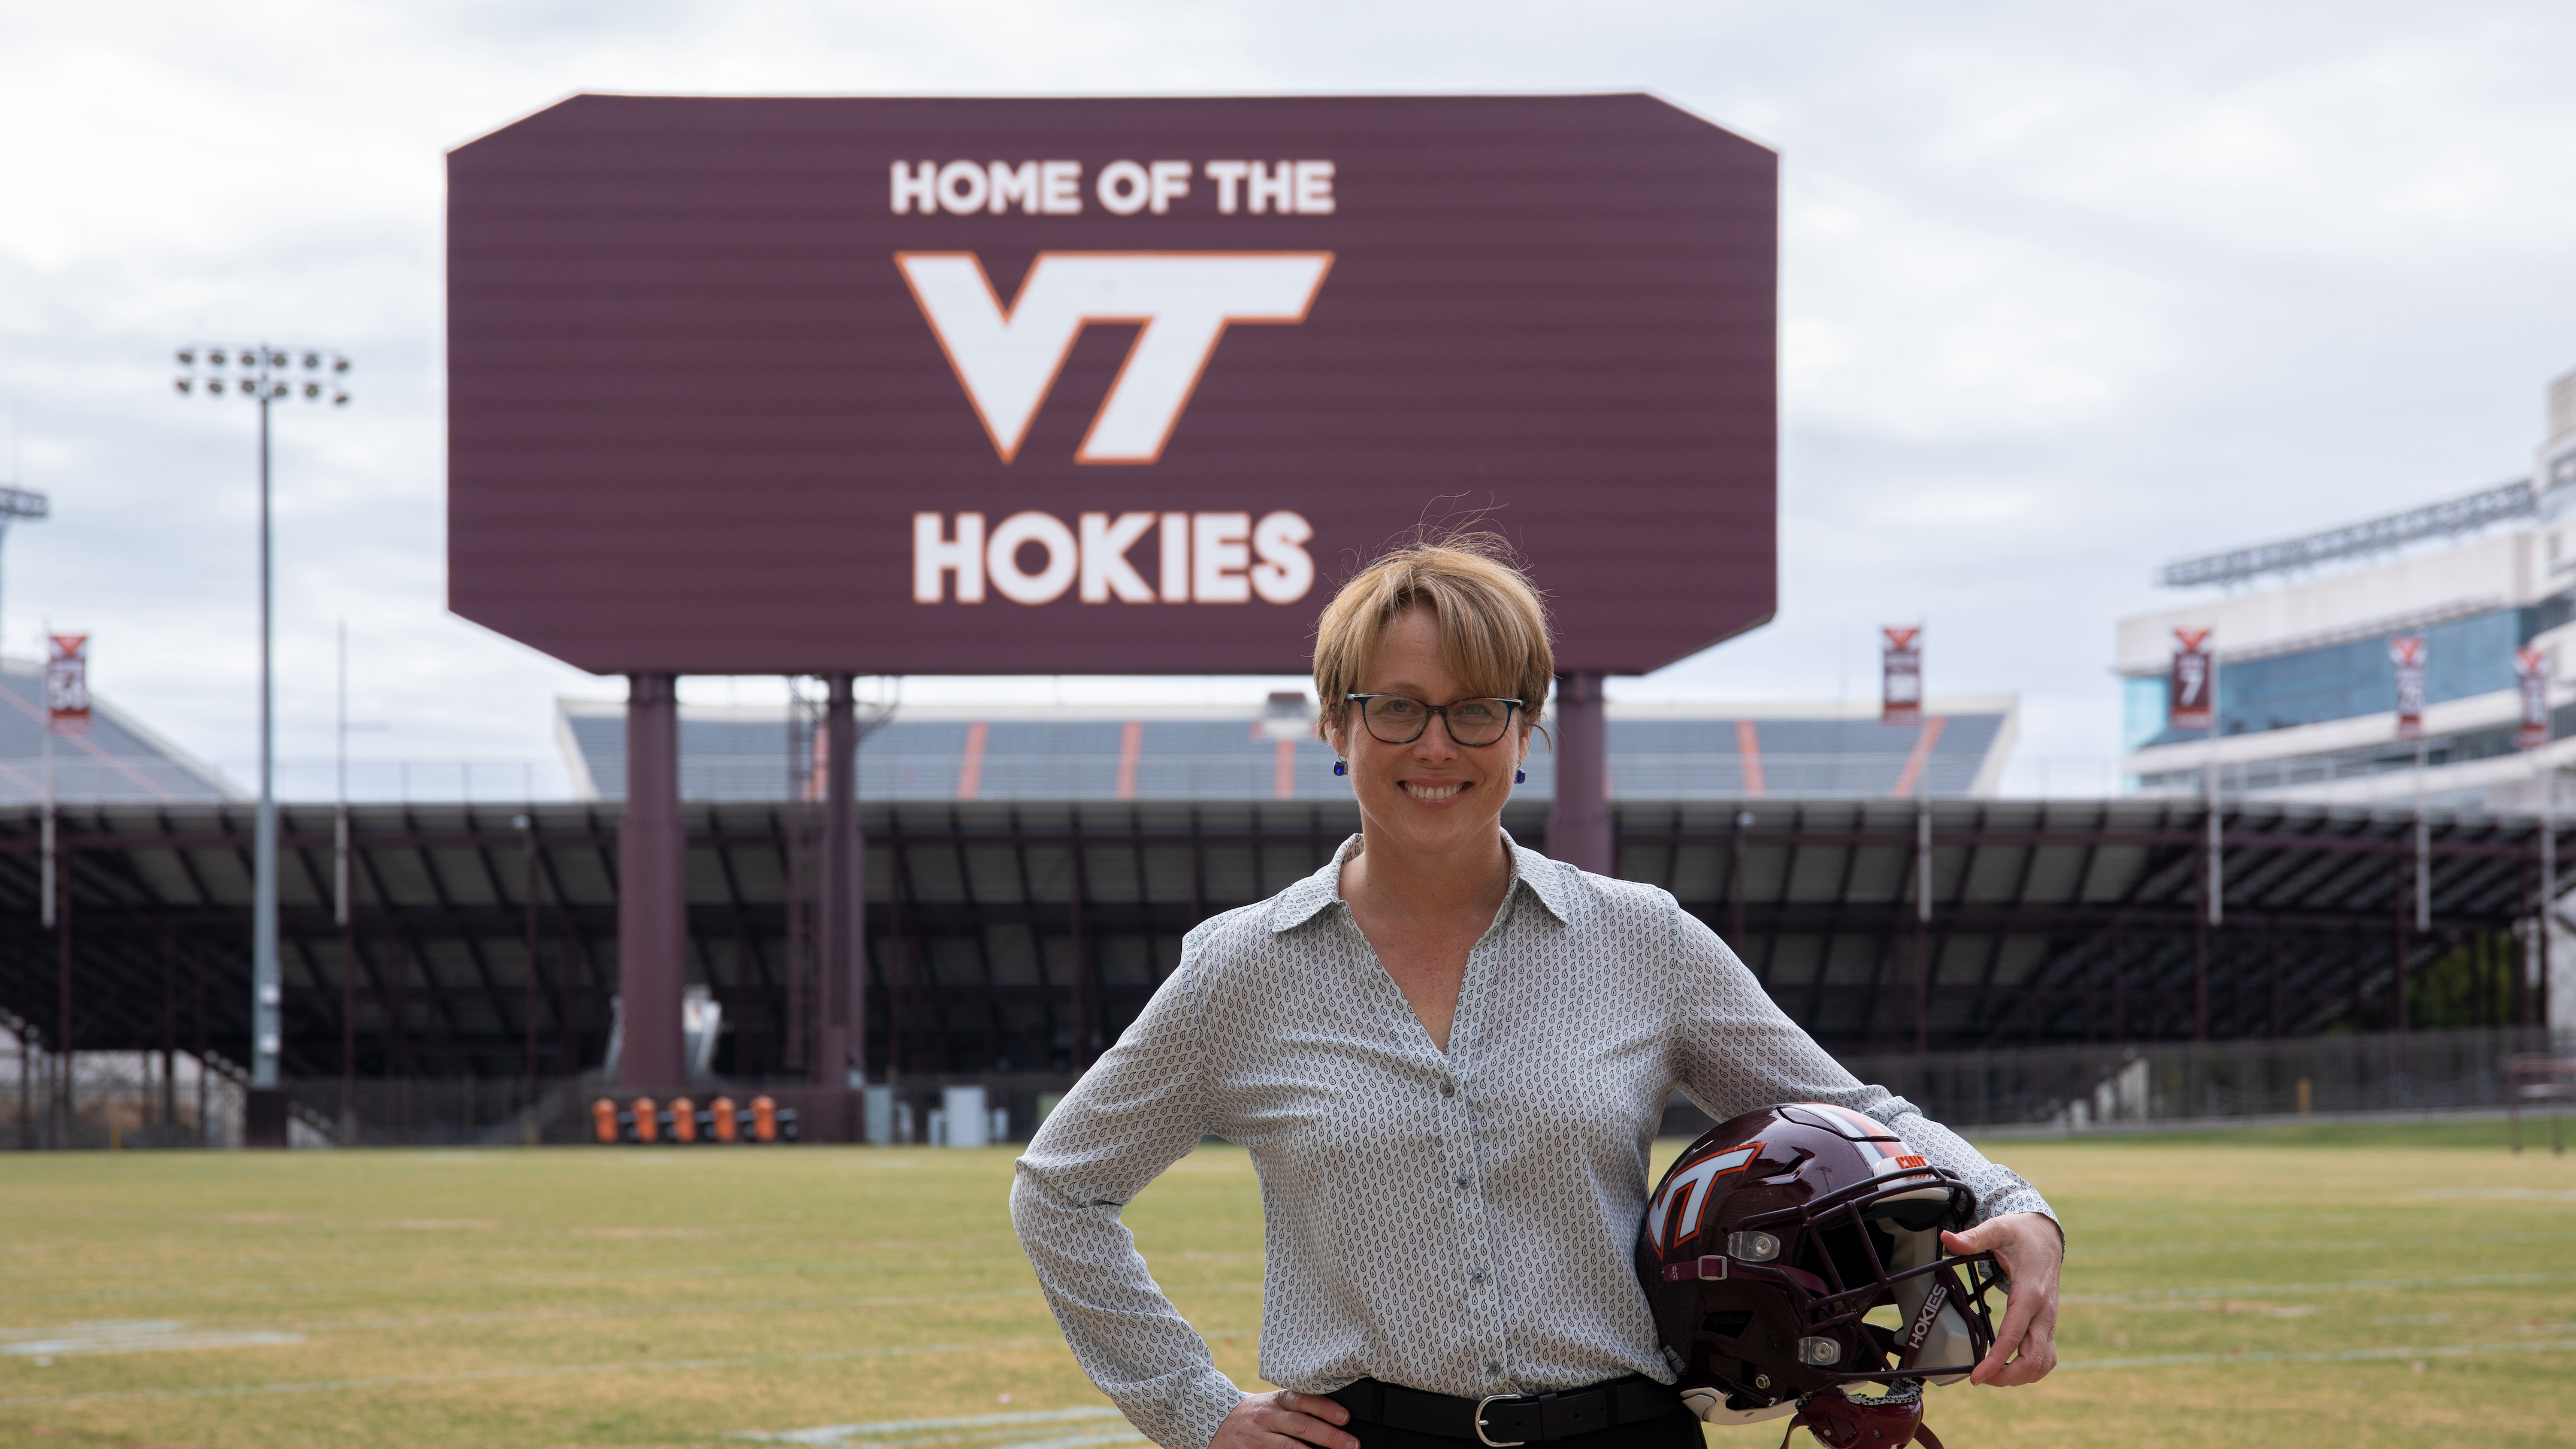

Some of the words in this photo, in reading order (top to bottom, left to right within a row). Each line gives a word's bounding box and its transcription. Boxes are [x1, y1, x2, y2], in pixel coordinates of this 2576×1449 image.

[890, 160, 1082, 214] HOME
[1096, 160, 1192, 214] OF
[1204, 160, 1336, 214] THE
[893, 250, 1337, 465] VT
[913, 510, 1316, 605] HOKIES
[2179, 667, 2205, 707] 7
[1647, 1142, 1767, 1261] VT
[1909, 1284, 1948, 1349] HOKIES
